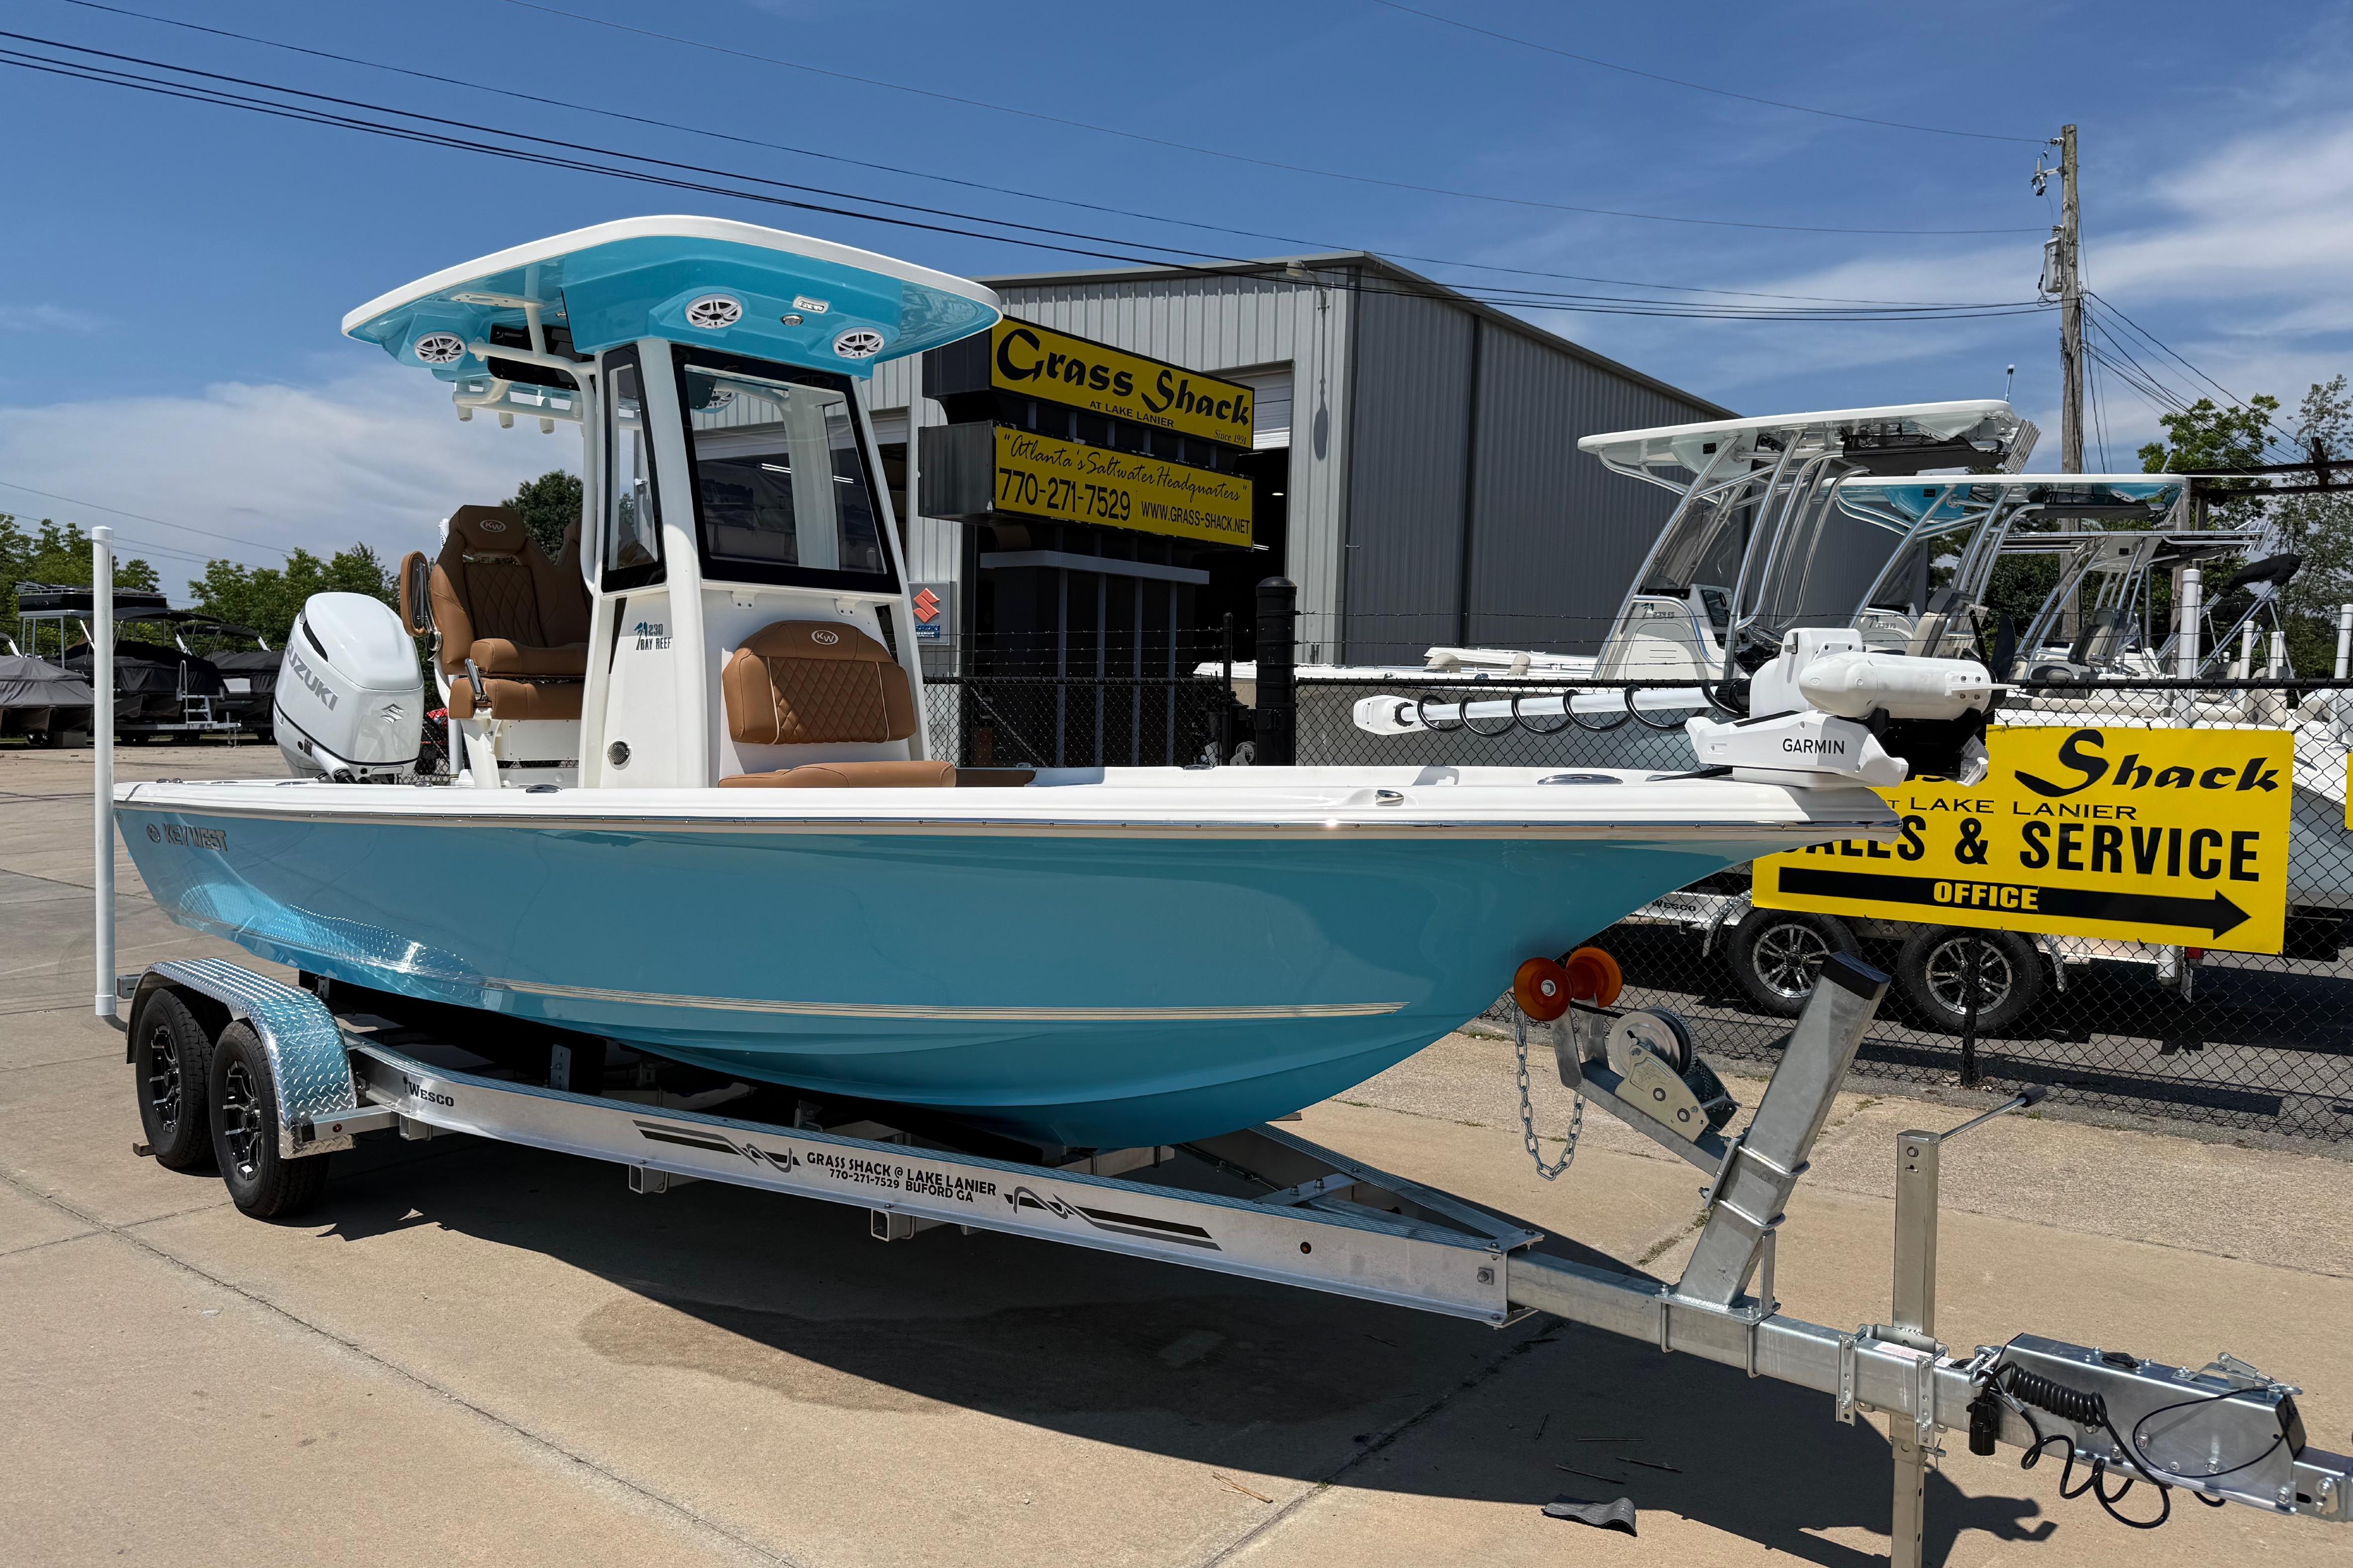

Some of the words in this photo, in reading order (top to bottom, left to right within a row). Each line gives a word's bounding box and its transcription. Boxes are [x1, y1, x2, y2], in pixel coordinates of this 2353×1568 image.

[996, 328, 1134, 396] Grass
[1141, 369, 1250, 426] Shack
[1090, 400, 1102, 409] AT
[1106, 403, 1133, 417] LAKE
[1136, 411, 1174, 428] LANIER
[1214, 429, 1231, 442] Since
[1234, 434, 1246, 445] 1991
[1086, 451, 1155, 485] Saltwater
[999, 467, 1131, 521] 770-271-7529
[1141, 500, 1250, 535] WWW.GRASS-SHACK.NET
[640, 638, 653, 651] BAY
[655, 637, 671, 650] REEF
[648, 623, 663, 636] 230
[286, 635, 339, 711] SUZUKI
[1782, 738, 1844, 755] GARMIN
[2015, 729, 2280, 797] Shack
[1910, 796, 1994, 814] LAKE
[2013, 801, 2137, 820] LANIER
[1954, 817, 1989, 865] &
[2019, 820, 2260, 882] SERVICE
[1934, 881, 2039, 910] OFFICE
[408, 1081, 454, 1107] WESCO
[807, 1152, 845, 1170] GRASS
[848, 1159, 891, 1177] SHACK
[894, 1167, 903, 1179] @
[907, 1168, 943, 1186] LAKE
[946, 1175, 997, 1196] LANIER
[829, 1168, 900, 1189] 770-271-7529
[906, 1180, 953, 1198] BUFORD
[956, 1189, 974, 1203] GA
